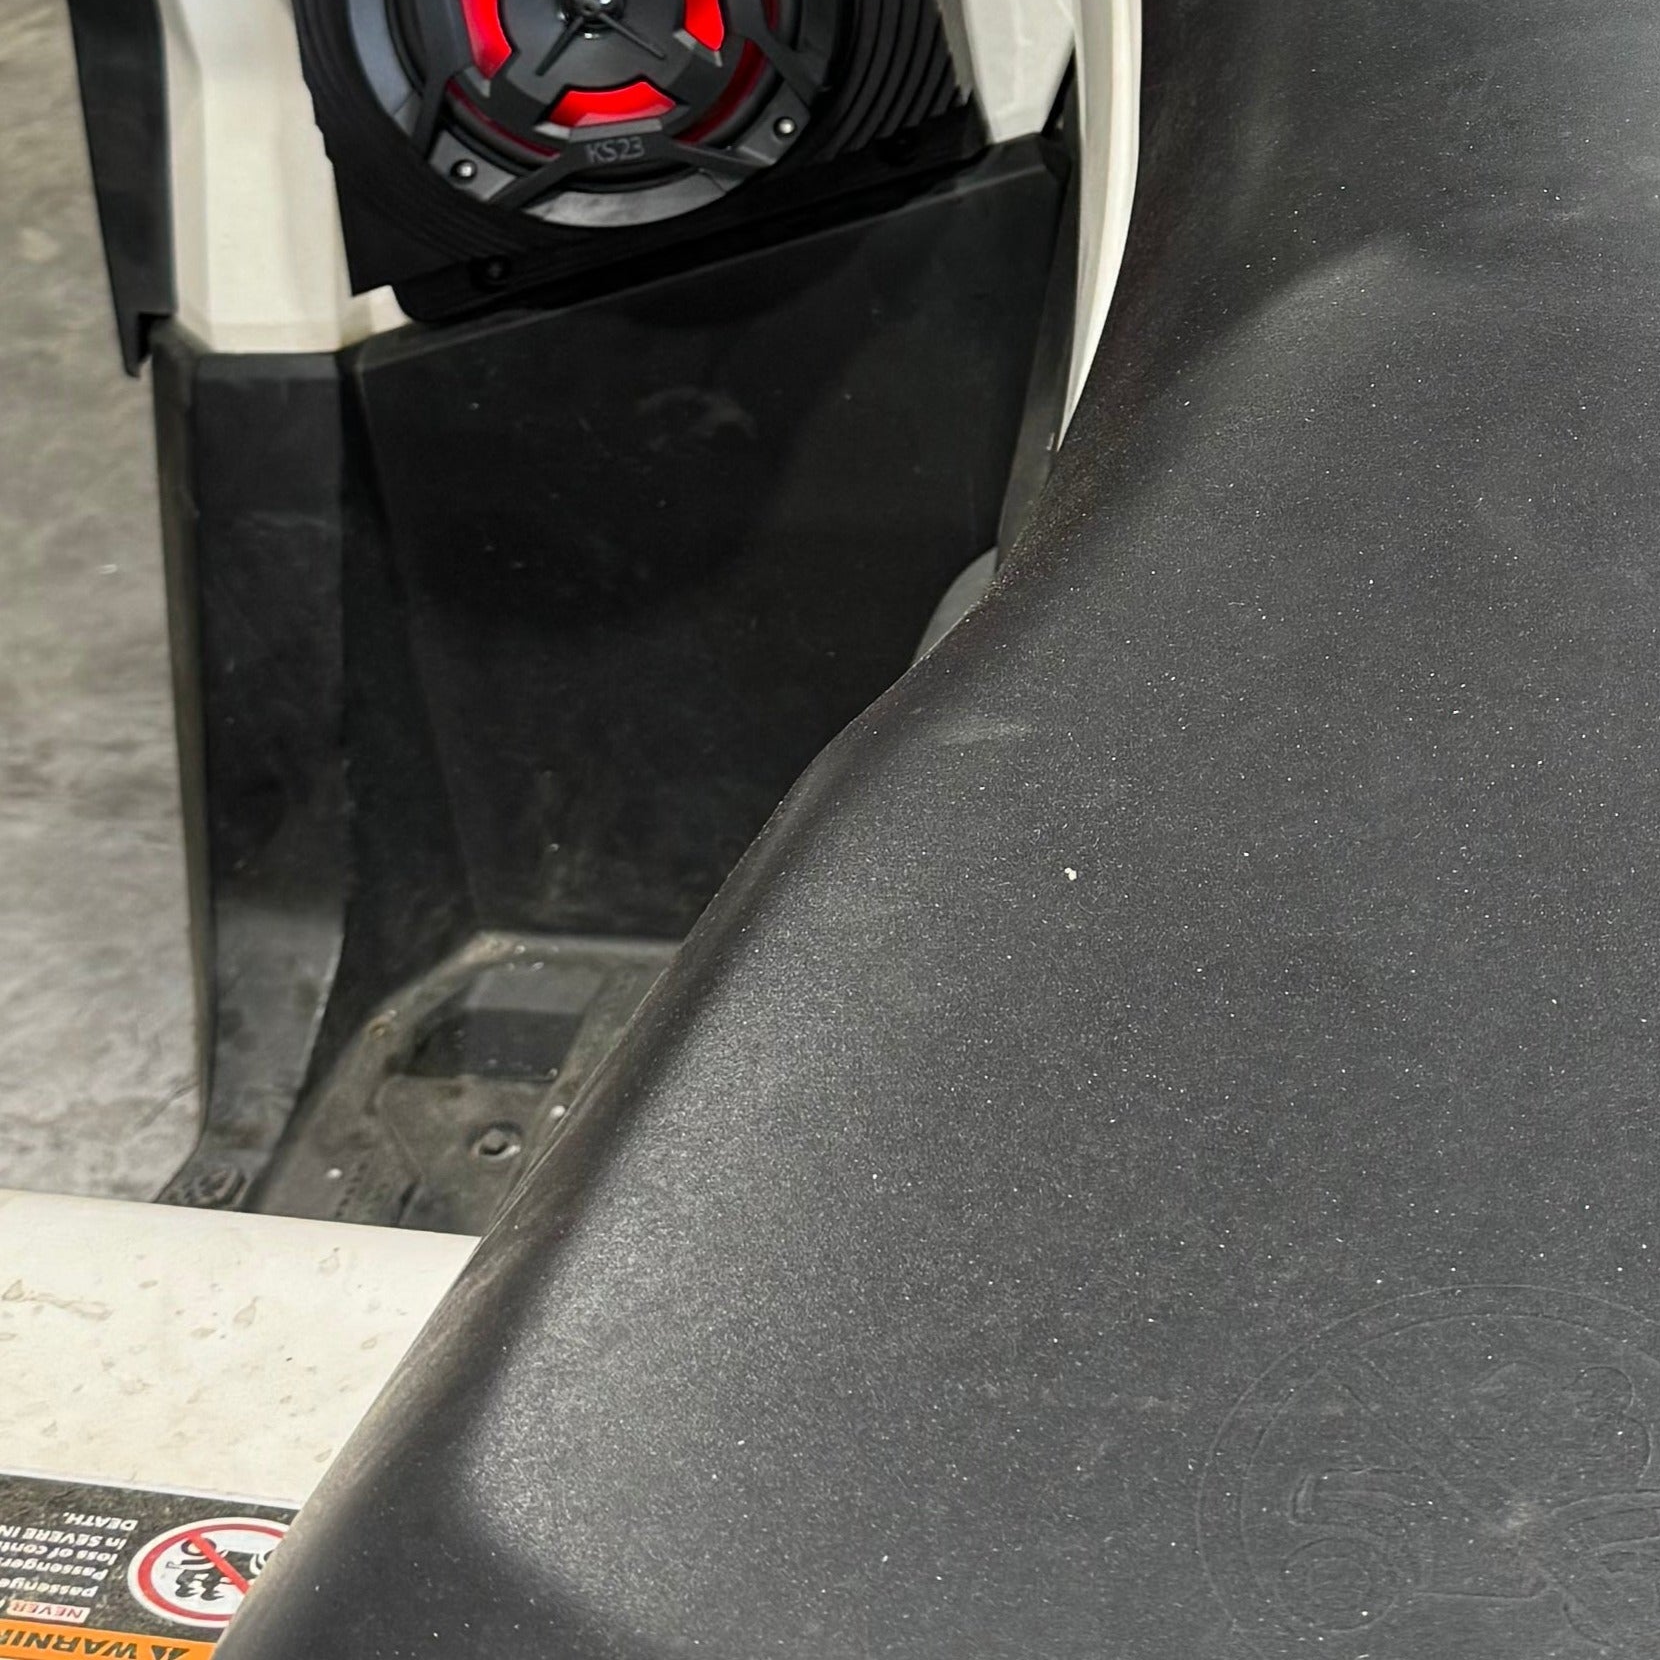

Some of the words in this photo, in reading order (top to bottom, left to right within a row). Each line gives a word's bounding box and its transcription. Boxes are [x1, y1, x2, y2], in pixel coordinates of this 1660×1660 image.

[584, 136, 645, 163] KS23
[22, 1527, 103, 1547] SEVERE
[47, 1547, 74, 1559] of
[76, 1549, 118, 1566] loss
[12, 1602, 84, 1618] NEVER
